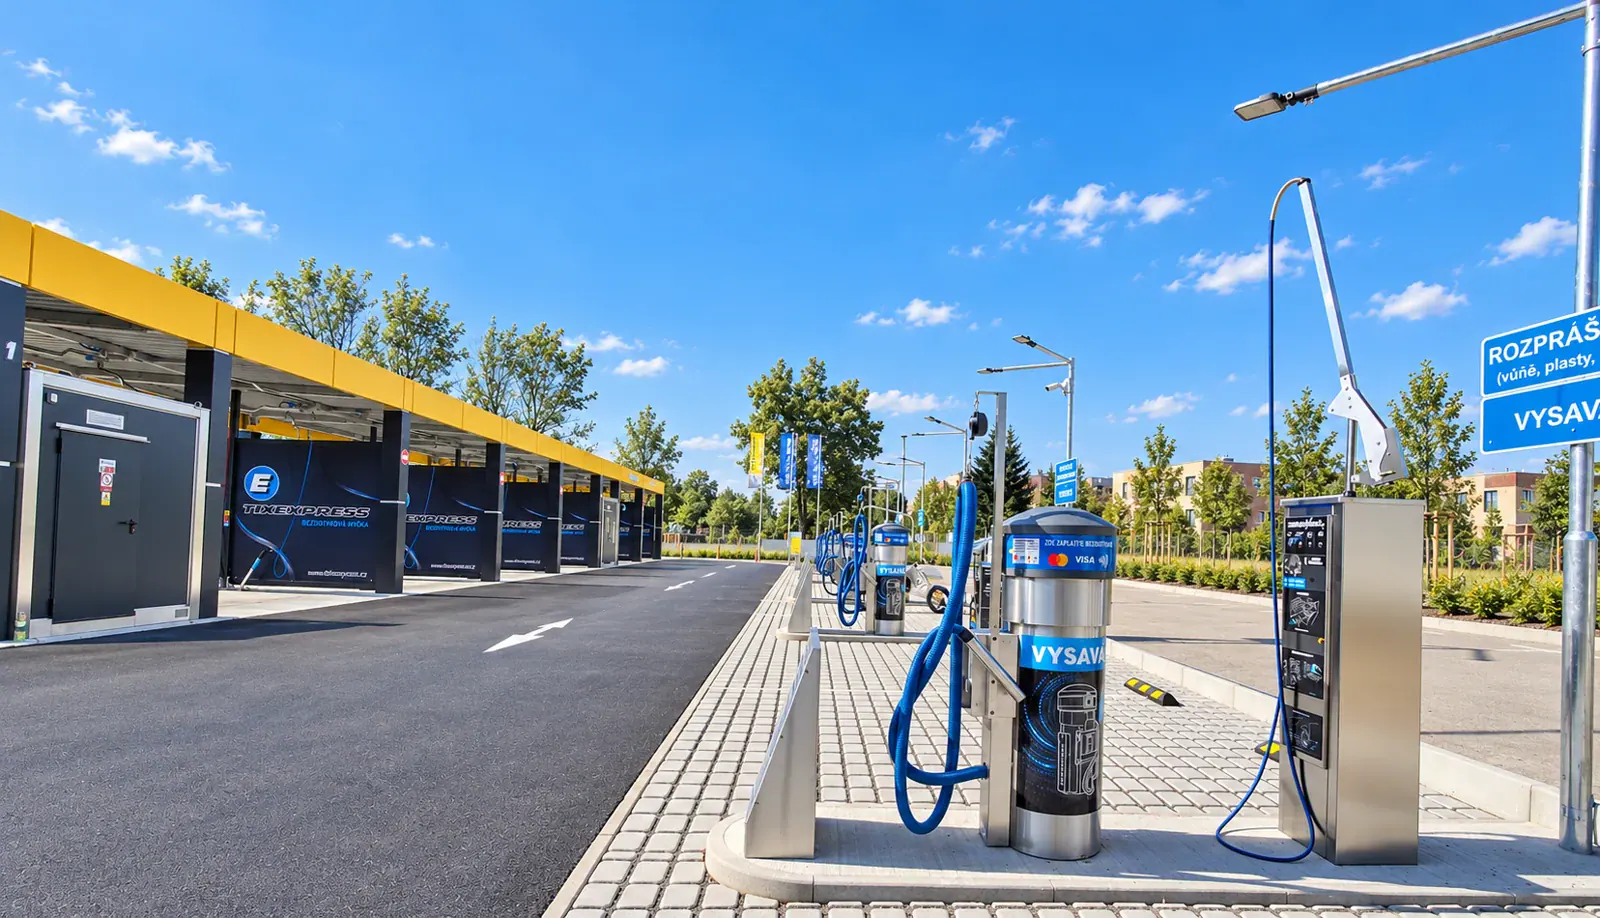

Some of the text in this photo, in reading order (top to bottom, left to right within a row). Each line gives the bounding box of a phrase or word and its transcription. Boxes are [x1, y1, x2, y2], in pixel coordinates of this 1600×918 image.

[1489, 316, 1600, 365] ROZPRÁŠ
[6, 341, 17, 360] 1
[1545, 353, 1595, 376] plasty,
[1514, 400, 1600, 431] VYSAV
[249, 473, 272, 493] E
[243, 503, 371, 518] TIXEXPRESS
[406, 514, 478, 525] EXPRESS
[1075, 555, 1095, 564] VISA
